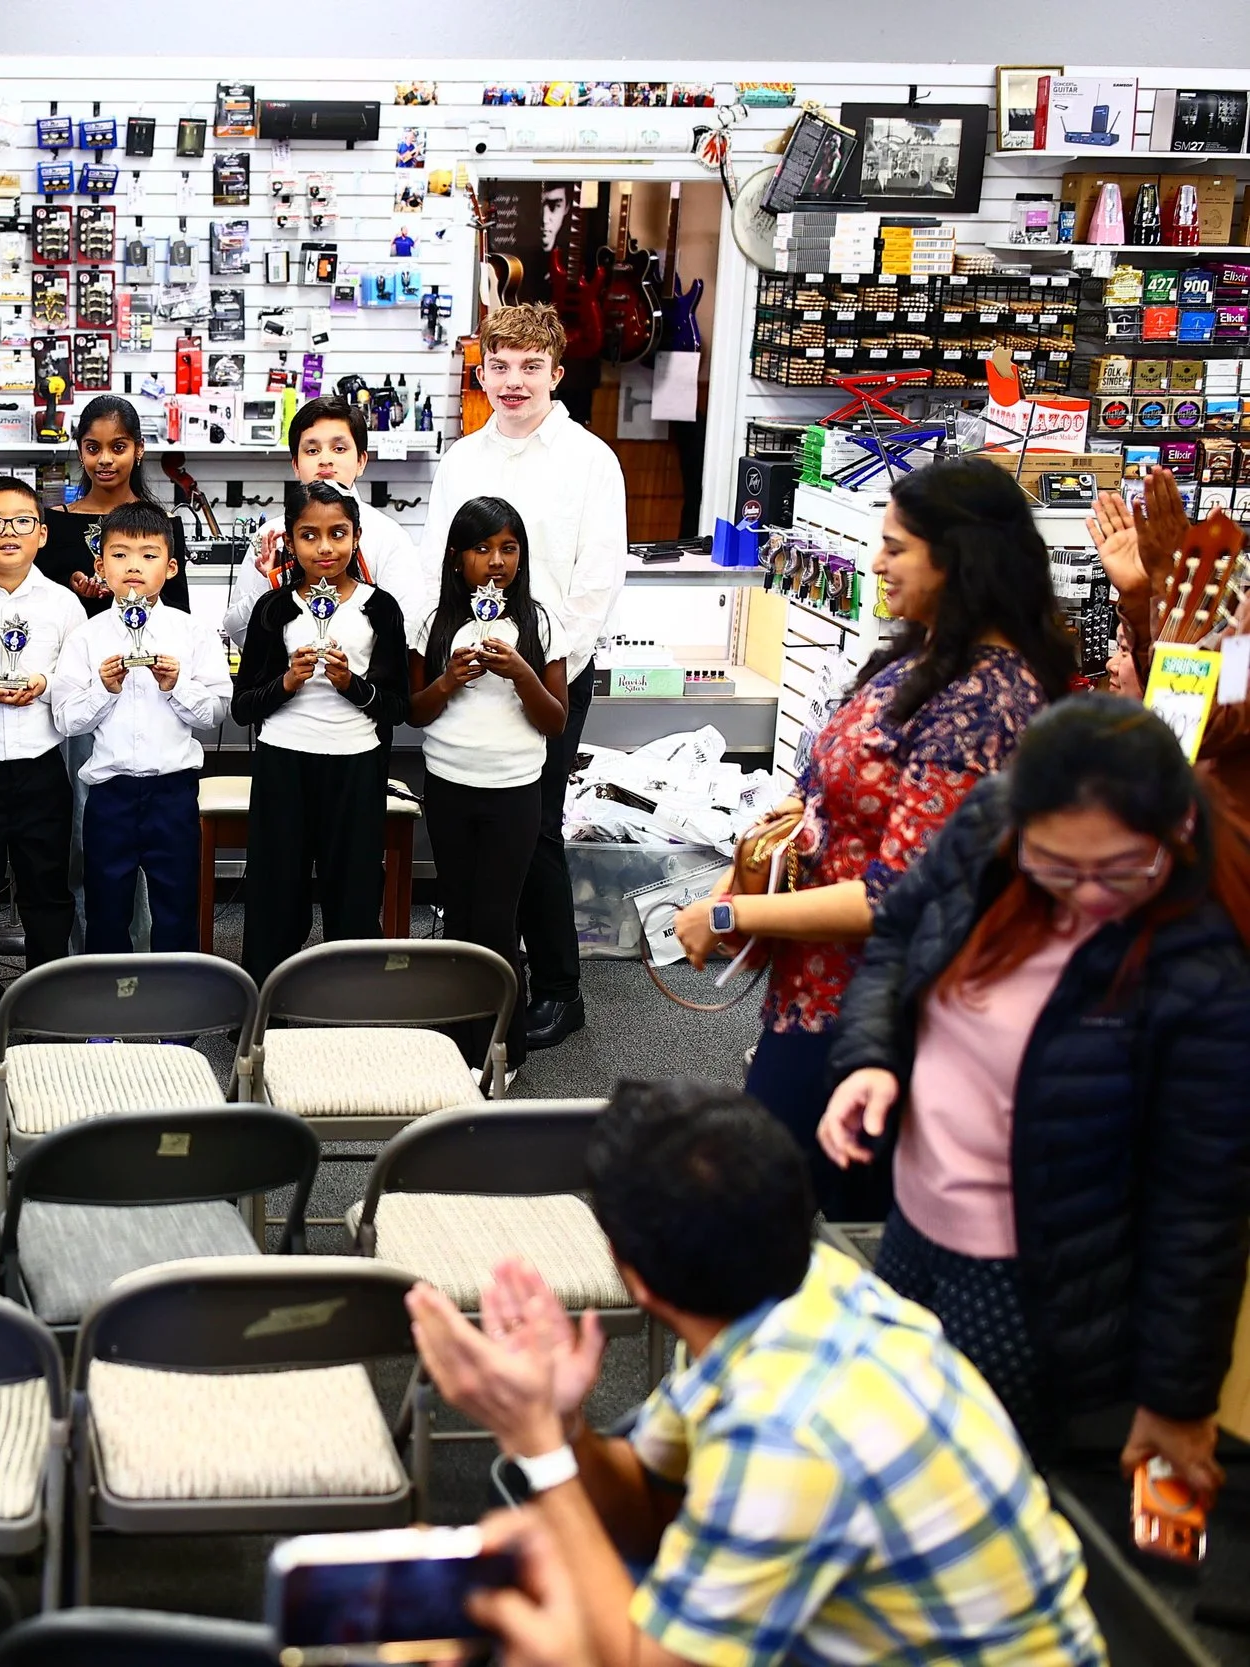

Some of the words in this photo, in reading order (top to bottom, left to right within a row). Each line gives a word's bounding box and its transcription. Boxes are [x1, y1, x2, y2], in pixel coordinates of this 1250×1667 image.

[1174, 141, 1205, 151] SM27
[1223, 270, 1248, 282] Elixir
[1148, 277, 1175, 293] 427
[1183, 280, 1210, 294] 900
[1220, 312, 1245, 323] Elixir
[1103, 367, 1122, 377] FOLK
[1021, 413, 1084, 432] KAZOO
[1168, 449, 1192, 460] Elixir
[618, 673, 648, 688] Ravish
[624, 684, 646, 694] Sitar
